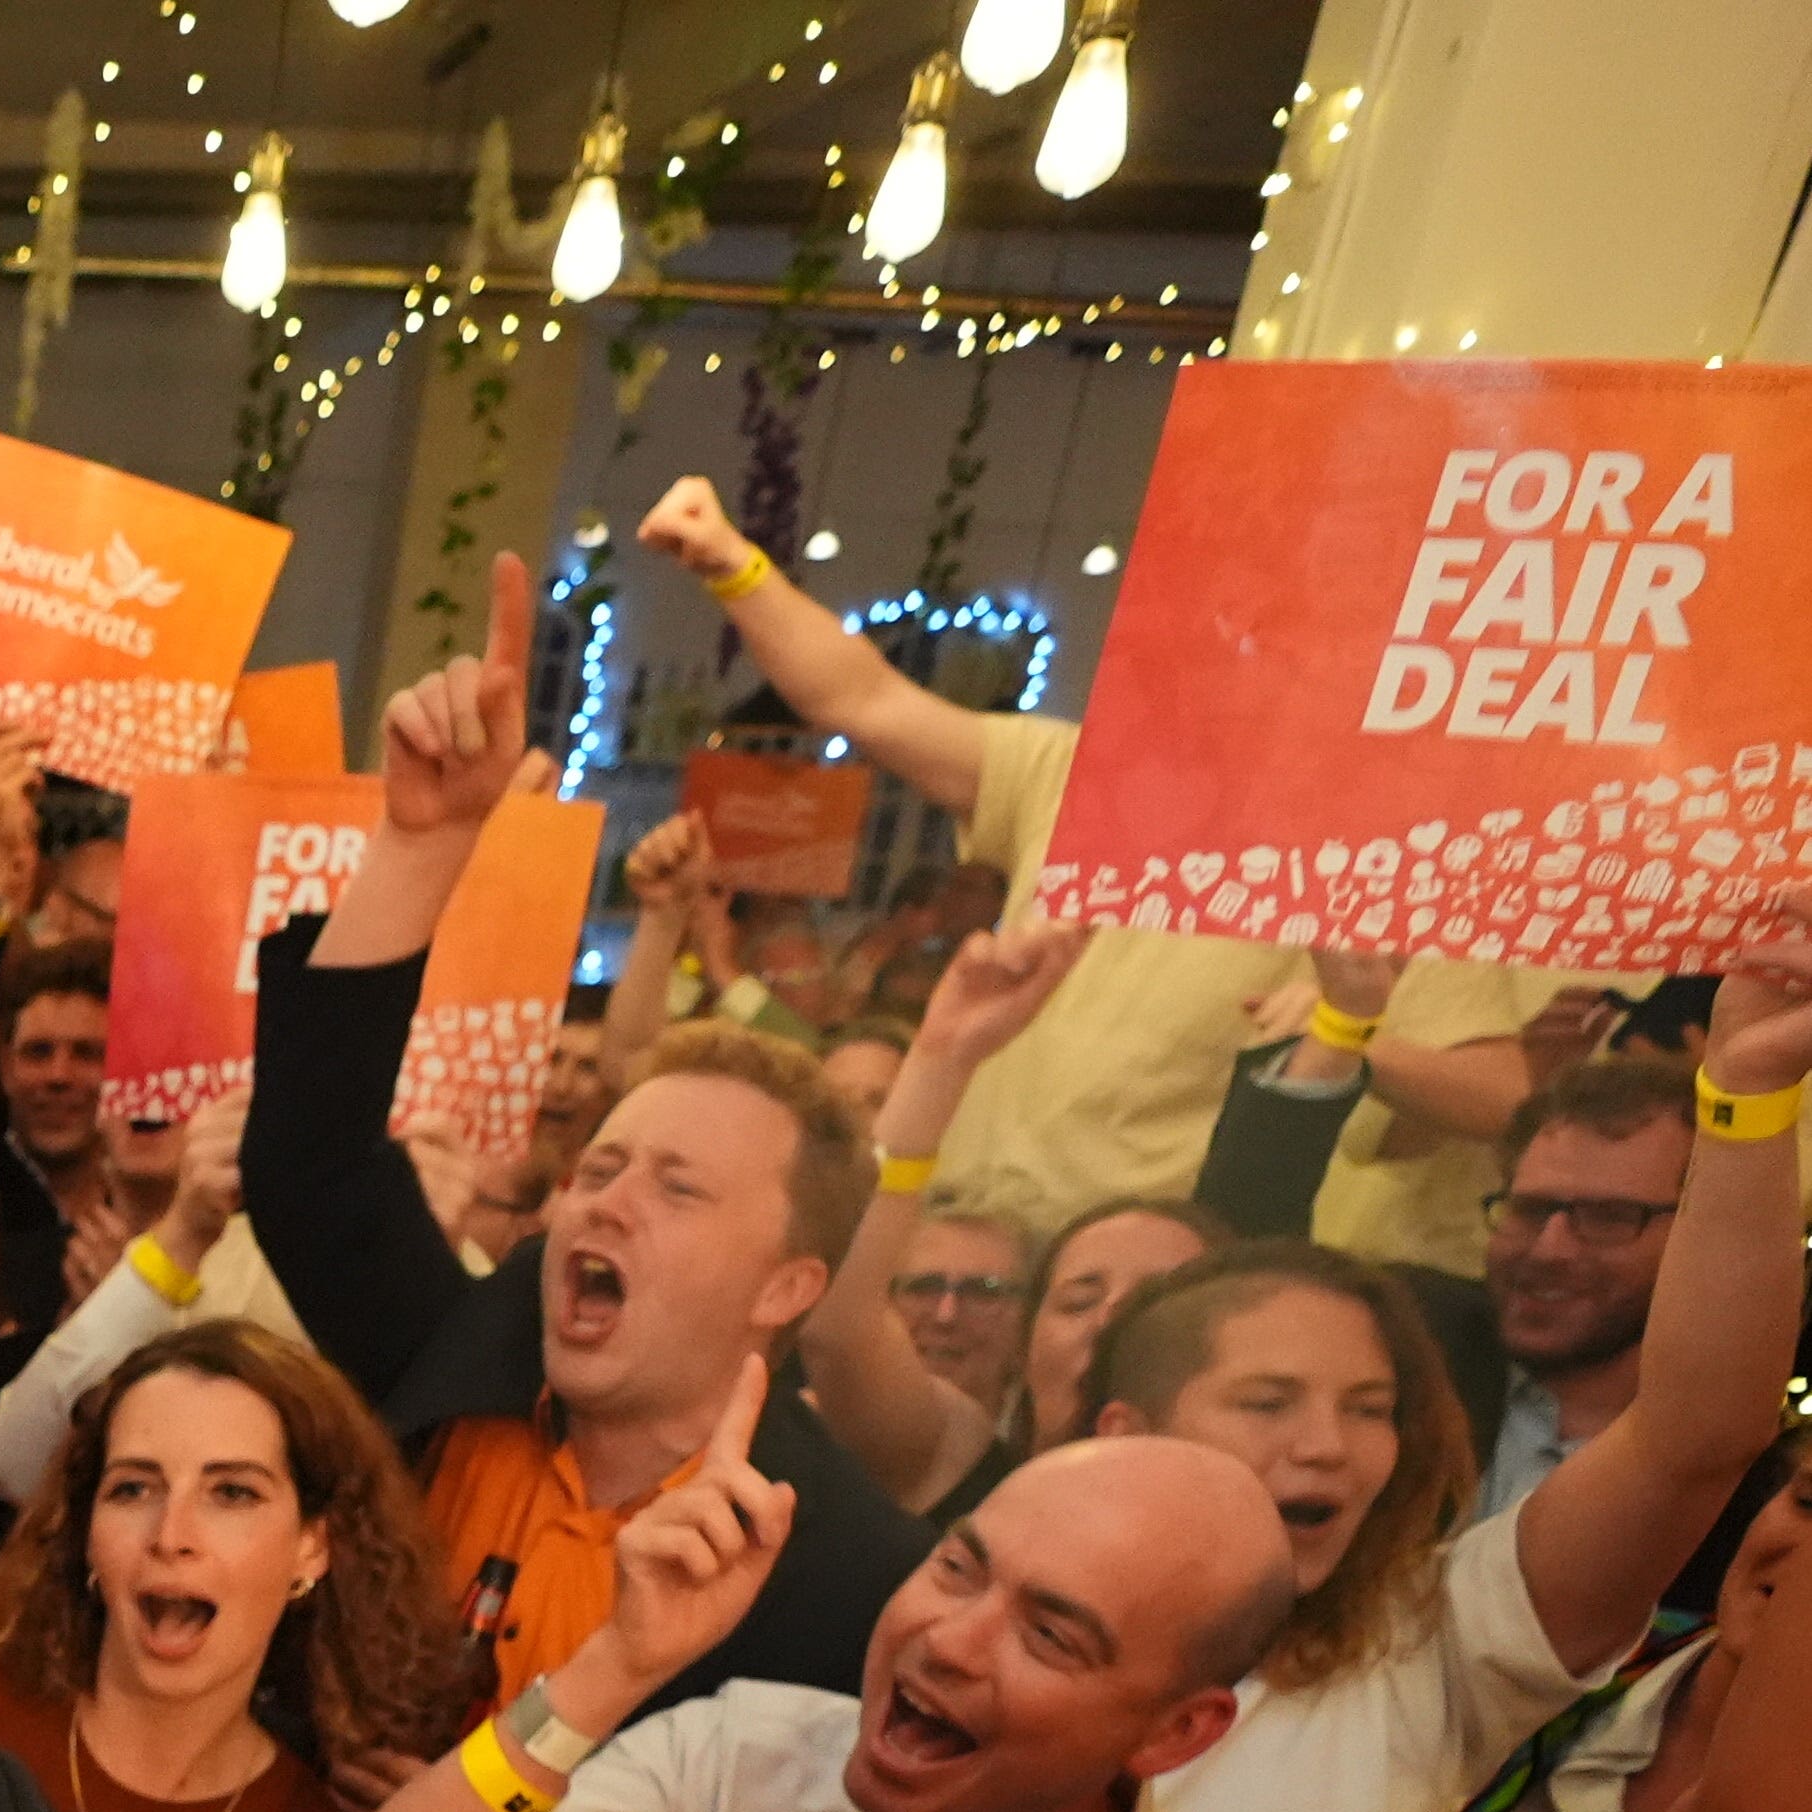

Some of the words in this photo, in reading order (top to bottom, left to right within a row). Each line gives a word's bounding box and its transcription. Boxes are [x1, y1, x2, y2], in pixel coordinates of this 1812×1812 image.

[1425, 449, 1644, 535] FOR
[1649, 453, 1734, 538] A
[1391, 537, 1706, 649] FAIR
[1360, 644, 1666, 745] DEAL
[258, 821, 367, 877] FOR
